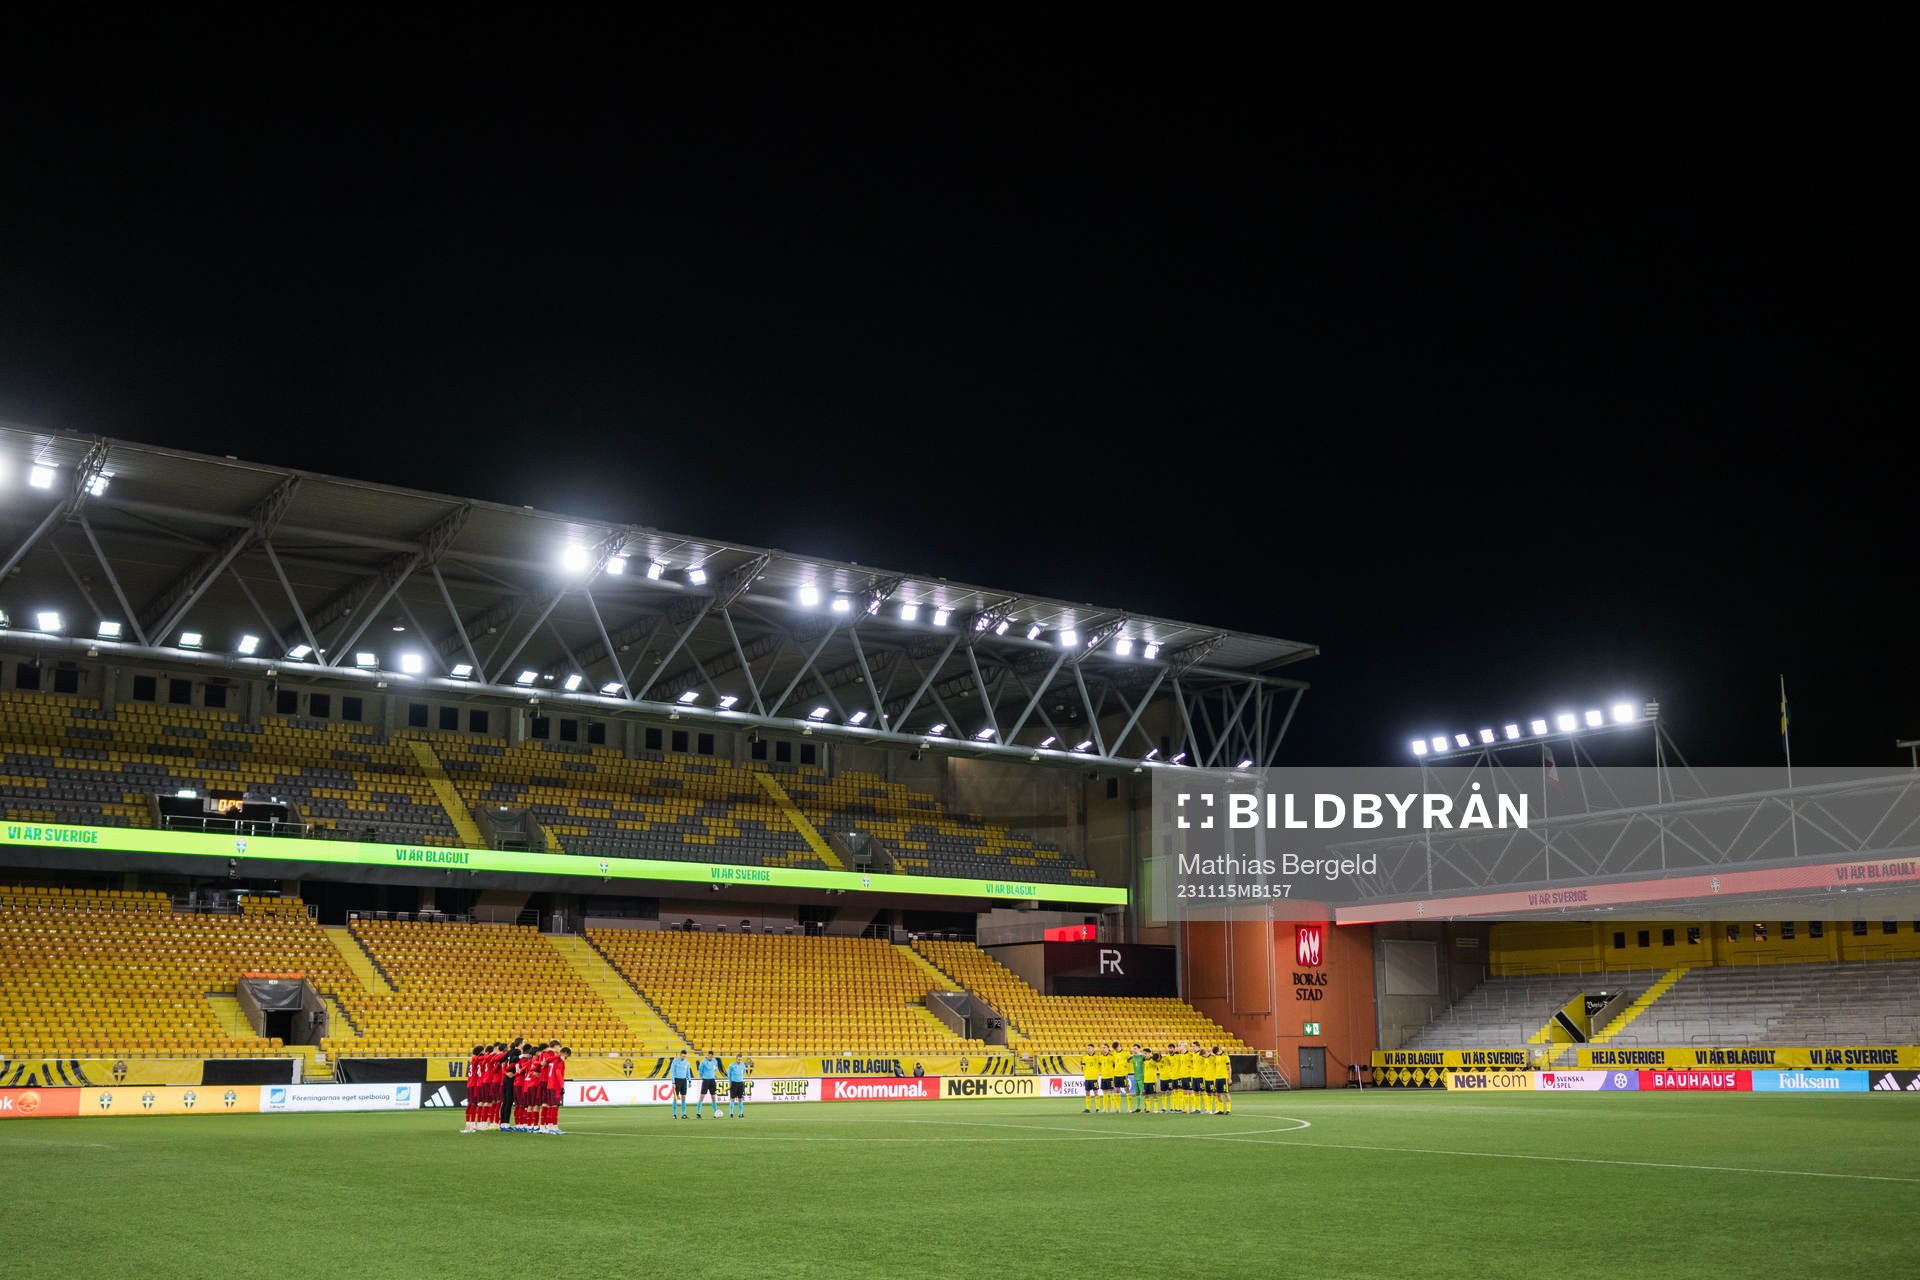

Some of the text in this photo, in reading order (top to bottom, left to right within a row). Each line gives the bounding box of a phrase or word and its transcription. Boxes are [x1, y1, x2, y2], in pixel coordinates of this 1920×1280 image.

[8, 826, 21, 839] VI
[45, 828, 98, 843] SVERIGE
[396, 849, 407, 861] VI
[408, 848, 423, 861] ÄR
[711, 868, 720, 878] VI
[735, 869, 770, 881] SVERIGE
[1836, 867, 1848, 880] VI
[1850, 865, 1865, 879] ÄR
[1528, 894, 1538, 905] VI
[1551, 890, 1588, 904] SVERIGE
[1292, 970, 1327, 986] BORÅS
[1295, 988, 1323, 1001] STAD
[1384, 1053, 1394, 1064] VI
[1395, 1052, 1406, 1064] ÄR
[1461, 1051, 1525, 1065] VI ÄR SVERIGE
[1592, 1051, 1665, 1064] HEJA SVERIGE!
[1695, 1050, 1775, 1064] VI ÄR BLÅGULT
[1810, 1049, 1899, 1064] VI ÄR SVERIGE
[449, 1061, 462, 1077] VI
[548, 1063, 554, 1077] 7
[821, 1060, 833, 1073] VI
[836, 1058, 851, 1073] ÄR
[716, 1080, 754, 1096] SPT
[771, 1080, 808, 1095] SPORT
[1655, 1074, 1735, 1087] BAUHAUS
[1779, 1073, 1839, 1089] Folksam
[580, 1085, 609, 1102] ICA
